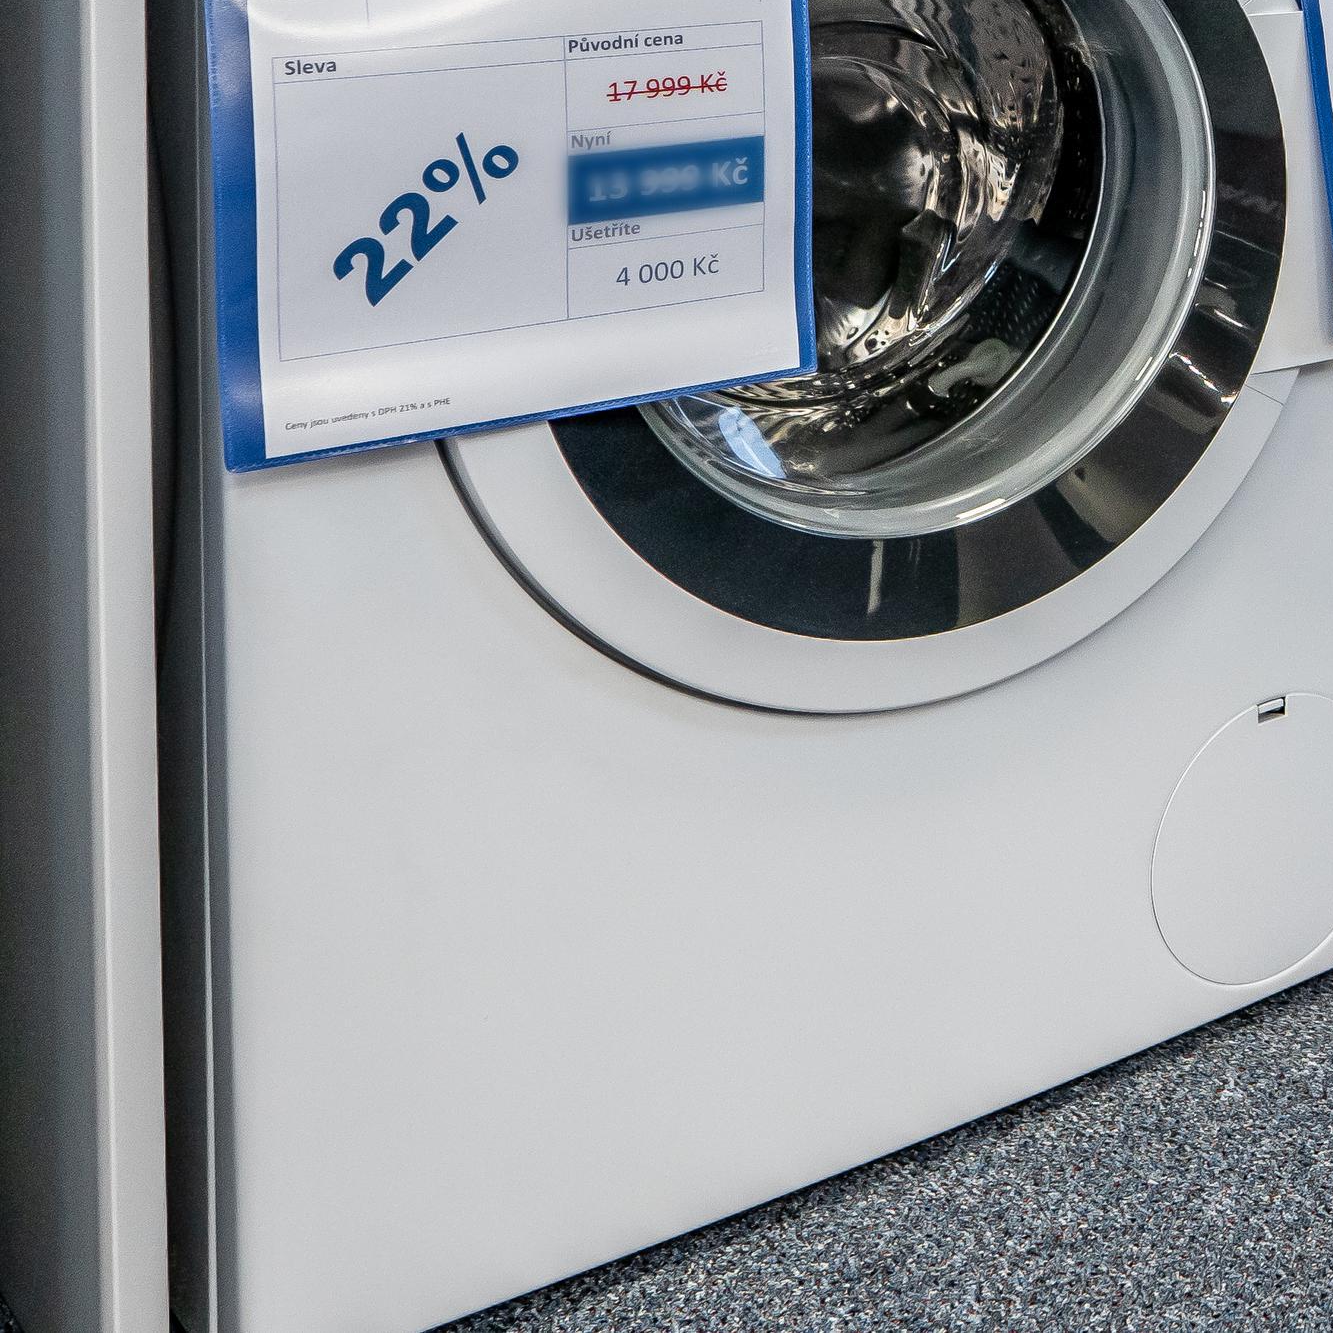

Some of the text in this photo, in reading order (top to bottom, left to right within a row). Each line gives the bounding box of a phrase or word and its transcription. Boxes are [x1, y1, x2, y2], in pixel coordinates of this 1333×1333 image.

[285, 33, 683, 76] Sleva Původní cena
[607, 72, 727, 103] 17 999 Kč
[571, 131, 611, 150] Nyní
[333, 132, 519, 307] 22%
[571, 221, 641, 243] Ušetříte
[616, 252, 720, 288] 4 000 Kč
[285, 421, 308, 430] Ceny
[309, 418, 329, 429] jsou
[331, 411, 369, 424] uvedeny
[378, 405, 397, 416] DPH
[433, 397, 451, 407] PHE
